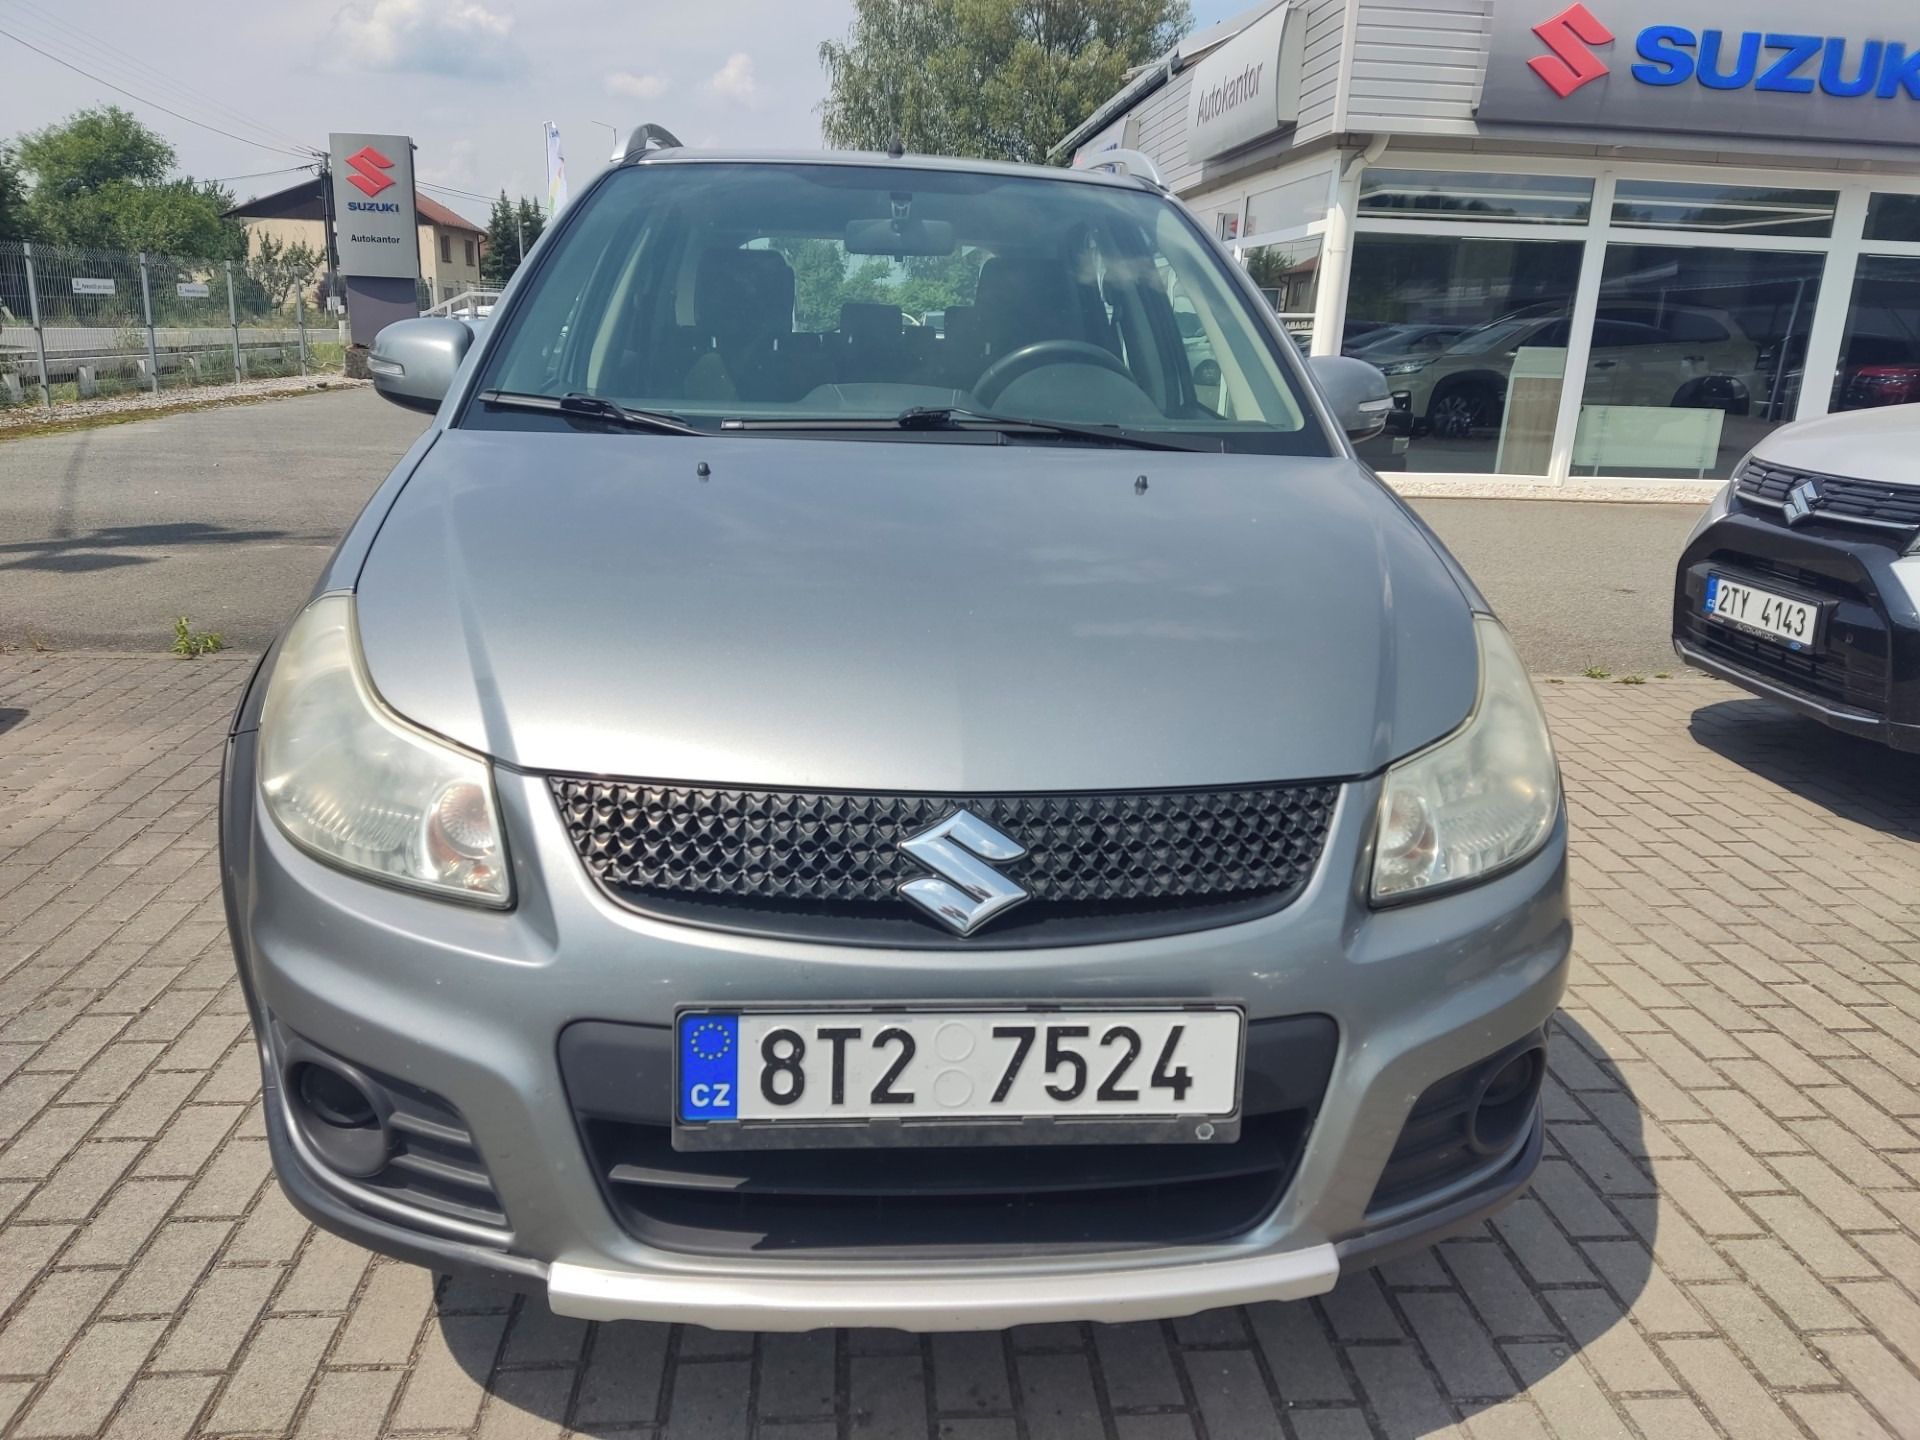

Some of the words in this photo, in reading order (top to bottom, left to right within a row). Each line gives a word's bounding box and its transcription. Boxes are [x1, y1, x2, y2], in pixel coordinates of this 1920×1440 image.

[1196, 62, 1264, 127] Autokantor
[347, 201, 400, 213] SUZUKI
[350, 233, 401, 244] Autokantor
[1718, 584, 1751, 619] 2TY
[1761, 597, 1807, 637] 4143
[759, 1026, 917, 1106] 8T2
[990, 1025, 1193, 1102] 7524
[690, 1083, 731, 1107] CZ
